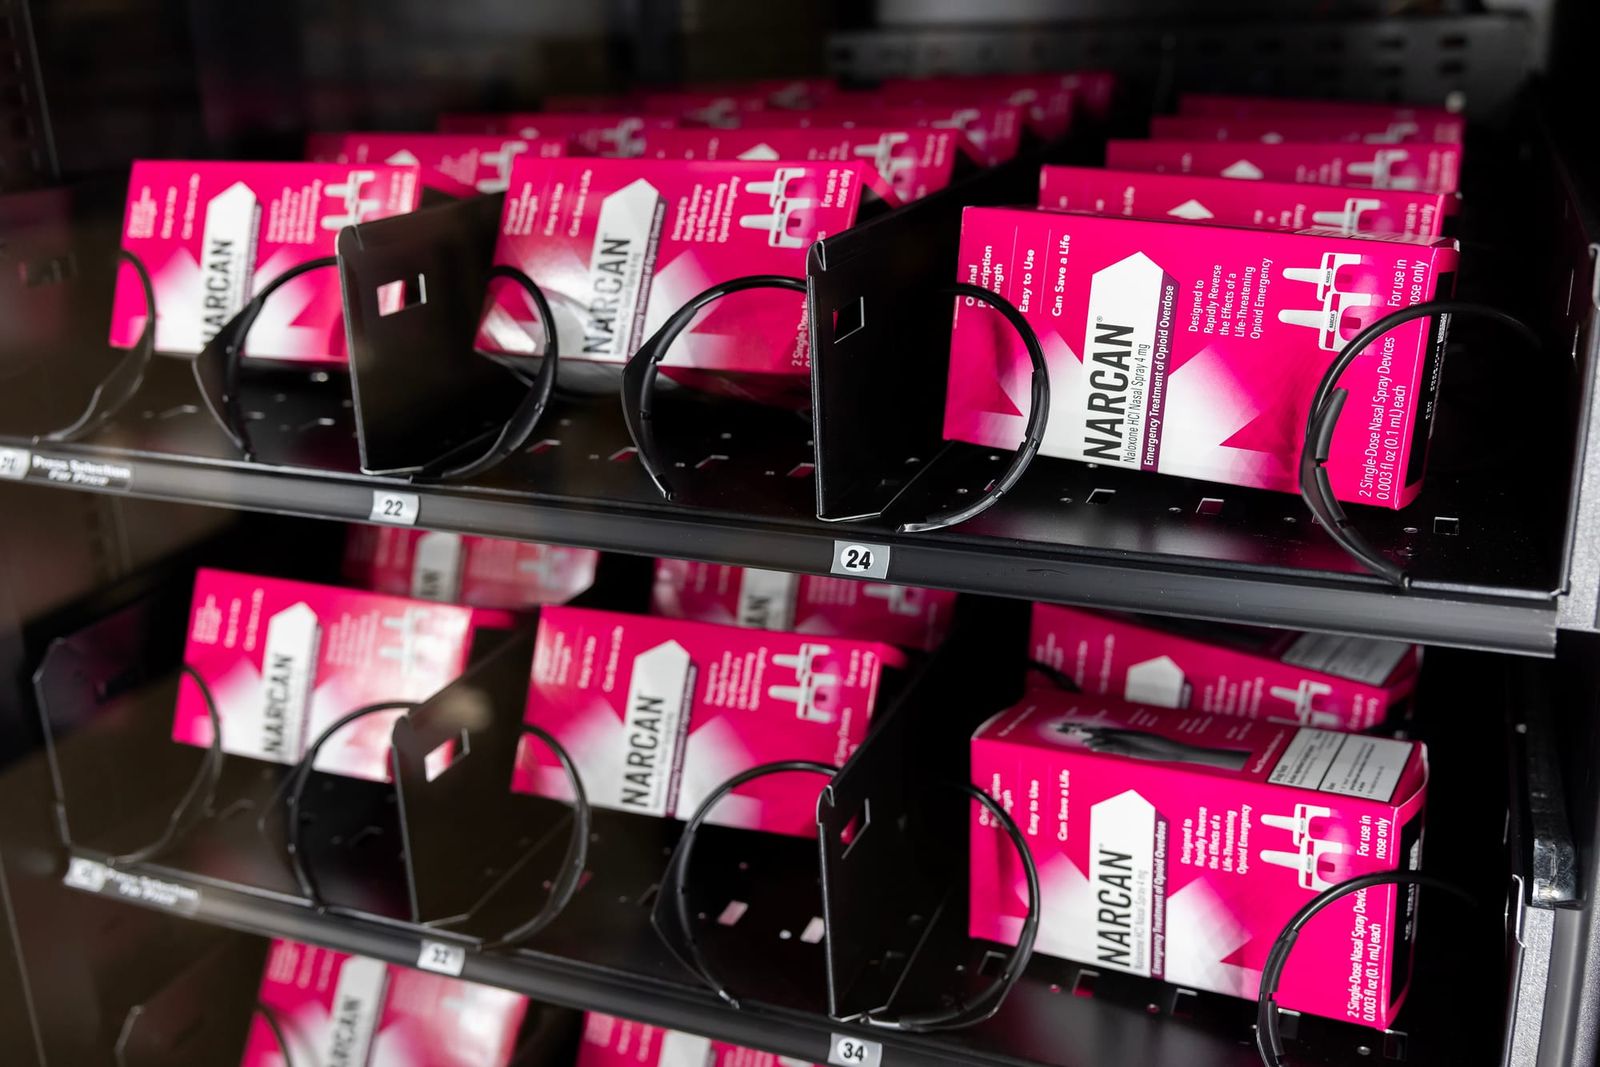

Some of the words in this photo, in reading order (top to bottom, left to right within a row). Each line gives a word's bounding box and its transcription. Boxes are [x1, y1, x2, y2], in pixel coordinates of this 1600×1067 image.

[1059, 234, 1071, 255] Life
[1023, 249, 1035, 270] Use
[1060, 257, 1068, 265] a
[1393, 259, 1407, 269] in
[1023, 273, 1032, 285] to
[1054, 267, 1067, 293] Save
[1207, 264, 1222, 299] Reverse
[1393, 271, 1406, 289] use
[1410, 260, 1429, 283] only
[1195, 280, 1204, 289] to
[1225, 279, 1236, 289] of
[1254, 257, 1273, 308] Emergency
[1018, 287, 1033, 313] Easy
[1051, 295, 1063, 317] Can
[1159, 285, 1175, 328] Overdose
[1221, 291, 1235, 319] Effects
[1234, 266, 1256, 337] Life-Threatening
[1387, 290, 1402, 307] For
[1188, 290, 1204, 332] Designed
[1203, 301, 1219, 334] Rapidly
[1219, 321, 1230, 336] the
[1250, 309, 1264, 339] Opioid
[1138, 343, 1151, 356] mg
[1155, 330, 1170, 359] Opioid
[1154, 360, 1165, 370] of
[1376, 337, 1395, 374] Devices
[1131, 365, 1148, 387] Spray
[1129, 388, 1142, 410] Nasal
[1149, 372, 1165, 416] Treatment
[1372, 375, 1393, 403] Spray
[1392, 385, 1407, 408] each
[1128, 410, 1140, 426] HCl
[1368, 404, 1385, 431] Nasal
[1388, 409, 1405, 428] mL)
[1123, 428, 1138, 463] Naloxone
[1144, 417, 1161, 466] Emergency
[1383, 430, 1400, 449] (0.1
[1360, 432, 1380, 489] Single-Dose
[1380, 462, 1394, 470] fl
[1385, 450, 1396, 462] oz
[1359, 489, 1372, 498] 2
[1376, 471, 1392, 500] 0.003
[384, 499, 404, 517] 22
[846, 549, 871, 570] 24
[1359, 815, 1372, 825] in
[1374, 817, 1391, 838] only
[1361, 825, 1371, 841] use
[1356, 841, 1369, 857] For
[1376, 838, 1387, 859] nose
[1351, 914, 1369, 938] Spray
[1368, 923, 1382, 944] each
[1350, 938, 1364, 962] Nasal
[1347, 962, 1363, 1011] Single-Dose
[1368, 978, 1378, 990] oz
[1347, 1010, 1360, 1018] 2
[1363, 996, 1376, 1022] 0.003
[843, 1042, 864, 1062] 34
